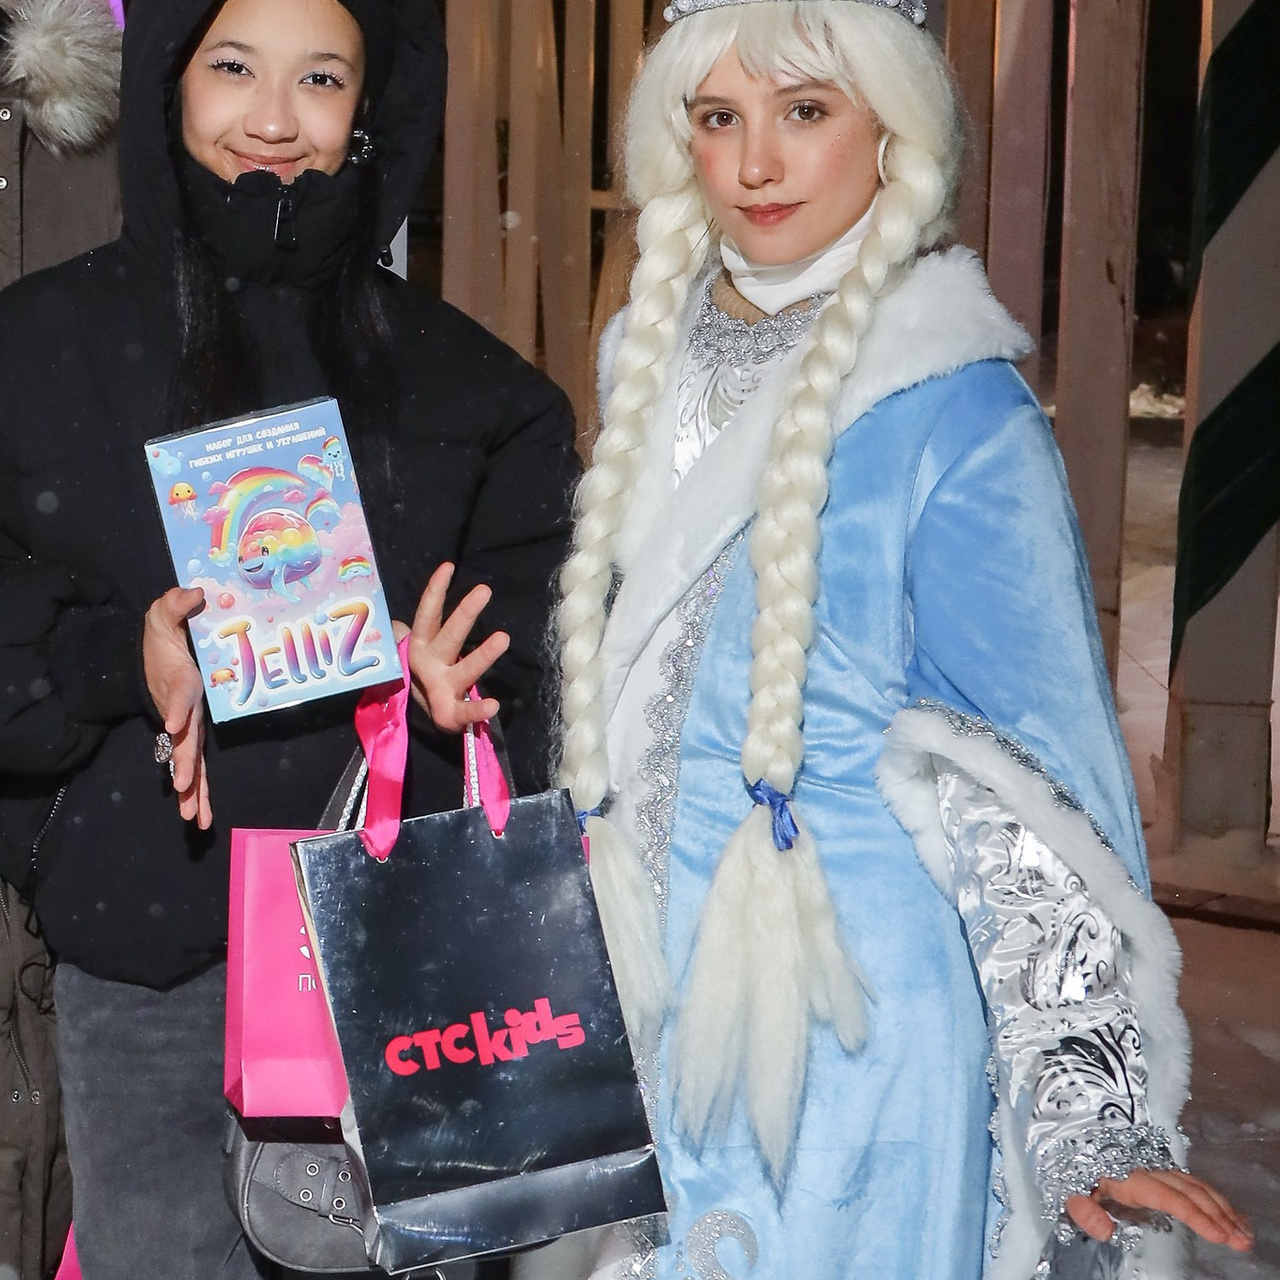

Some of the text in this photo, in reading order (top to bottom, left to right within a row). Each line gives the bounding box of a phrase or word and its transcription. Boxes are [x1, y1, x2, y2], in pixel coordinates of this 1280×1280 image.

[189, 426, 326, 468] ГИБКИХ ИГРУШЕК И УКРАШЕНИЙ
[236, 433, 253, 445] ДЛЯ
[256, 422, 299, 439] СОЗДАНИЯ
